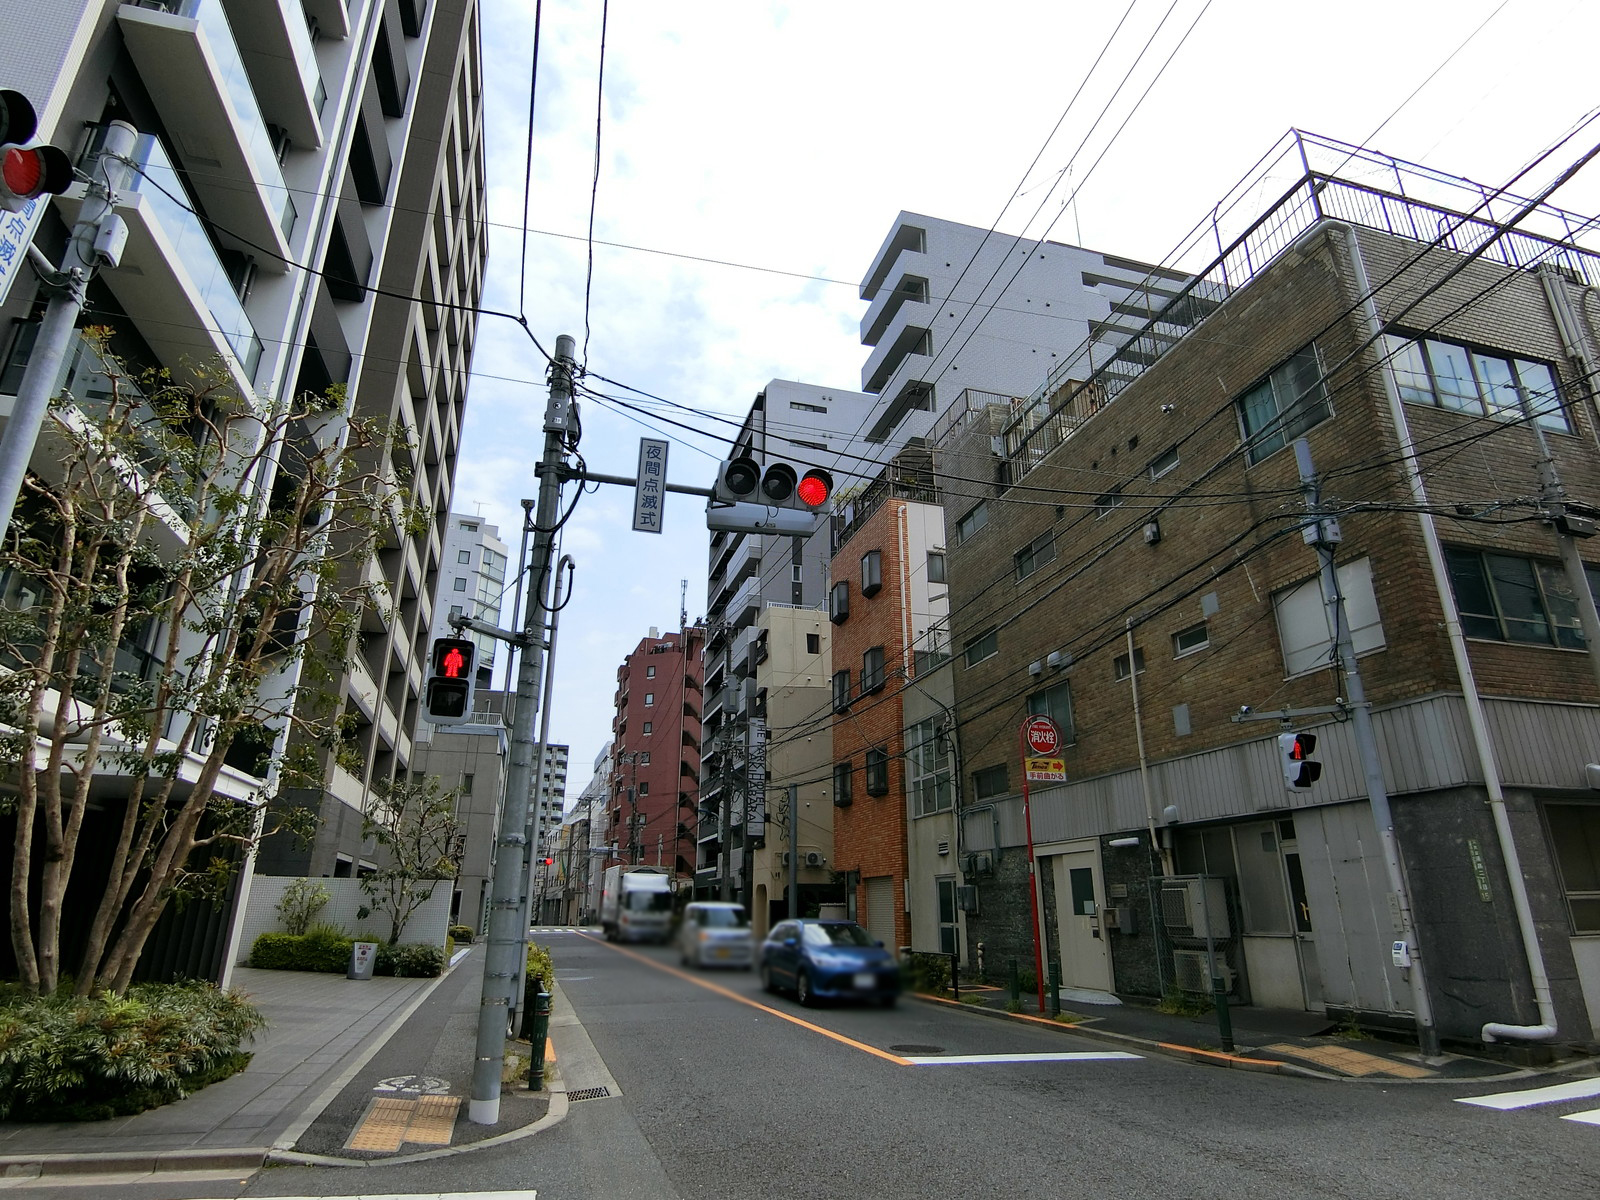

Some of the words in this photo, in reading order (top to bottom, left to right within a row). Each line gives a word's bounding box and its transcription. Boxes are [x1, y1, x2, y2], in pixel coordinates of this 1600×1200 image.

[640, 445, 662, 526] 夜間点滅式
[756, 717, 766, 738] THE
[1031, 730, 1055, 744] 消火栓
[756, 741, 766, 769] PARK
[748, 753, 758, 821] AKIHABARA
[1029, 771, 1064, 780] 手前曲がる
[756, 773, 766, 810] HOTEL
